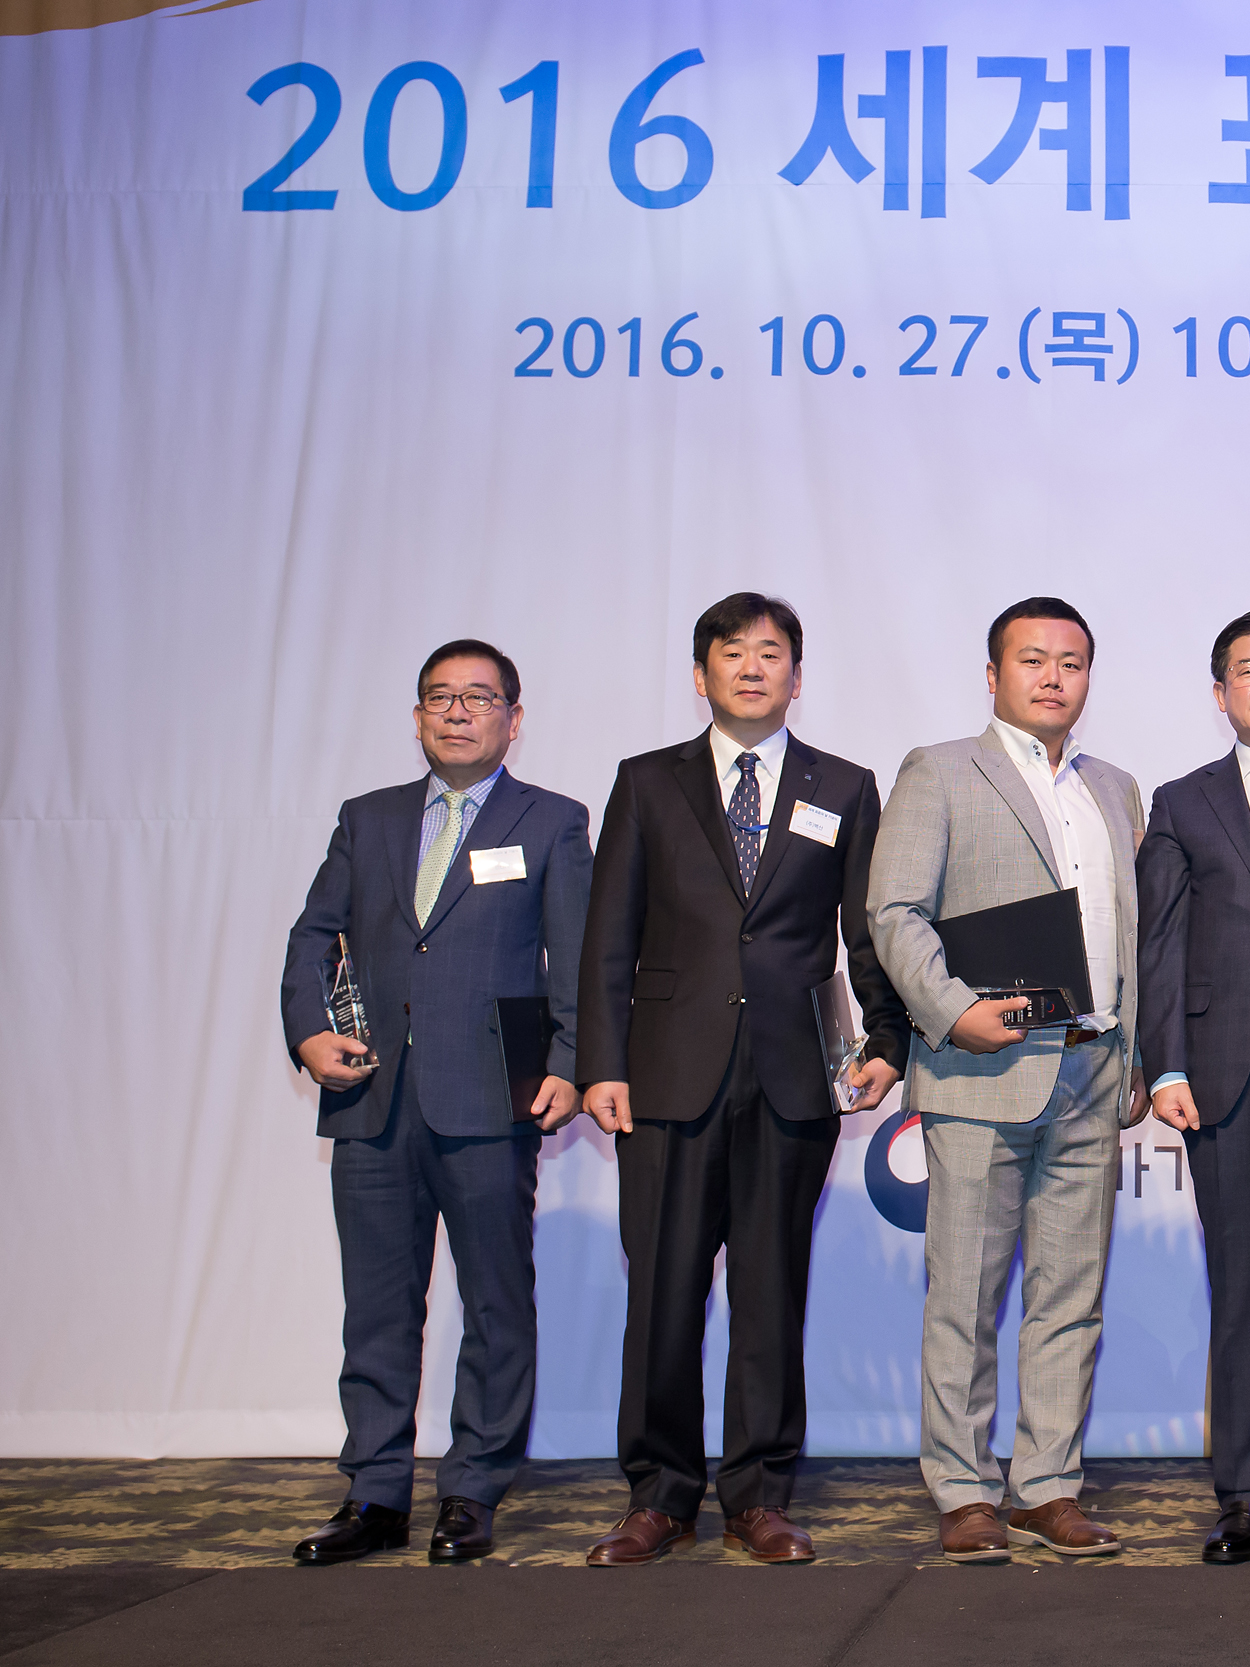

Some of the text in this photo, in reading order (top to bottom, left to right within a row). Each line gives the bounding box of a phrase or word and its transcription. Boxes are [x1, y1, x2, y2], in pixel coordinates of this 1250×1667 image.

[240, 46, 715, 213] 2016
[776, 44, 1132, 221] 세계
[513, 311, 724, 380] 2016.
[758, 313, 867, 379] 10.
[898, 306, 1140, 386] 27.(목)
